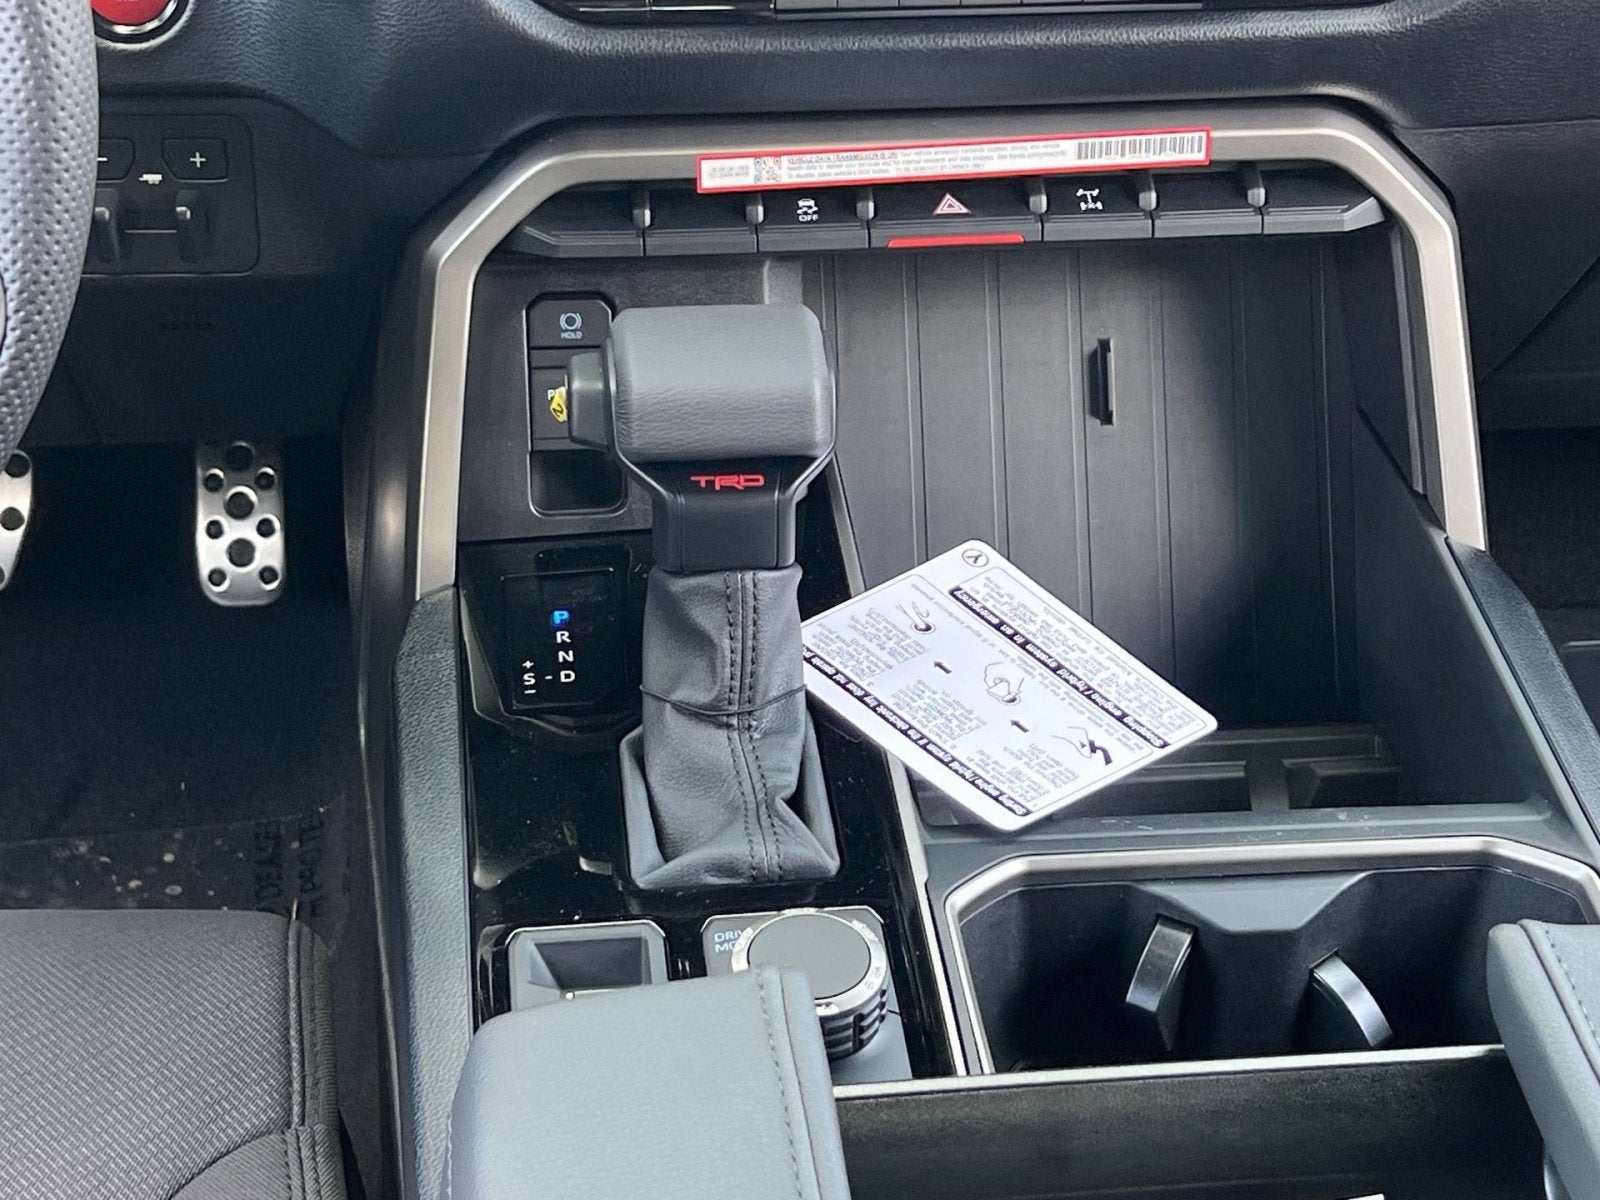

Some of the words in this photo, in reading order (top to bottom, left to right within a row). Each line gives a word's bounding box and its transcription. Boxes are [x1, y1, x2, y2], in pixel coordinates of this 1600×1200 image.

[798, 214, 819, 222] OFF
[560, 331, 583, 340] HOLD
[690, 474, 765, 491] TRD
[553, 610, 570, 625] P
[556, 630, 571, 643] R
[1010, 634, 1025, 643] in
[558, 650, 574, 663] N
[1023, 642, 1060, 667] system
[523, 672, 536, 686] S
[560, 670, 576, 683] D
[1055, 667, 1089, 690] hybrid
[1121, 715, 1166, 747] Stopping
[714, 928, 744, 942] DRIV
